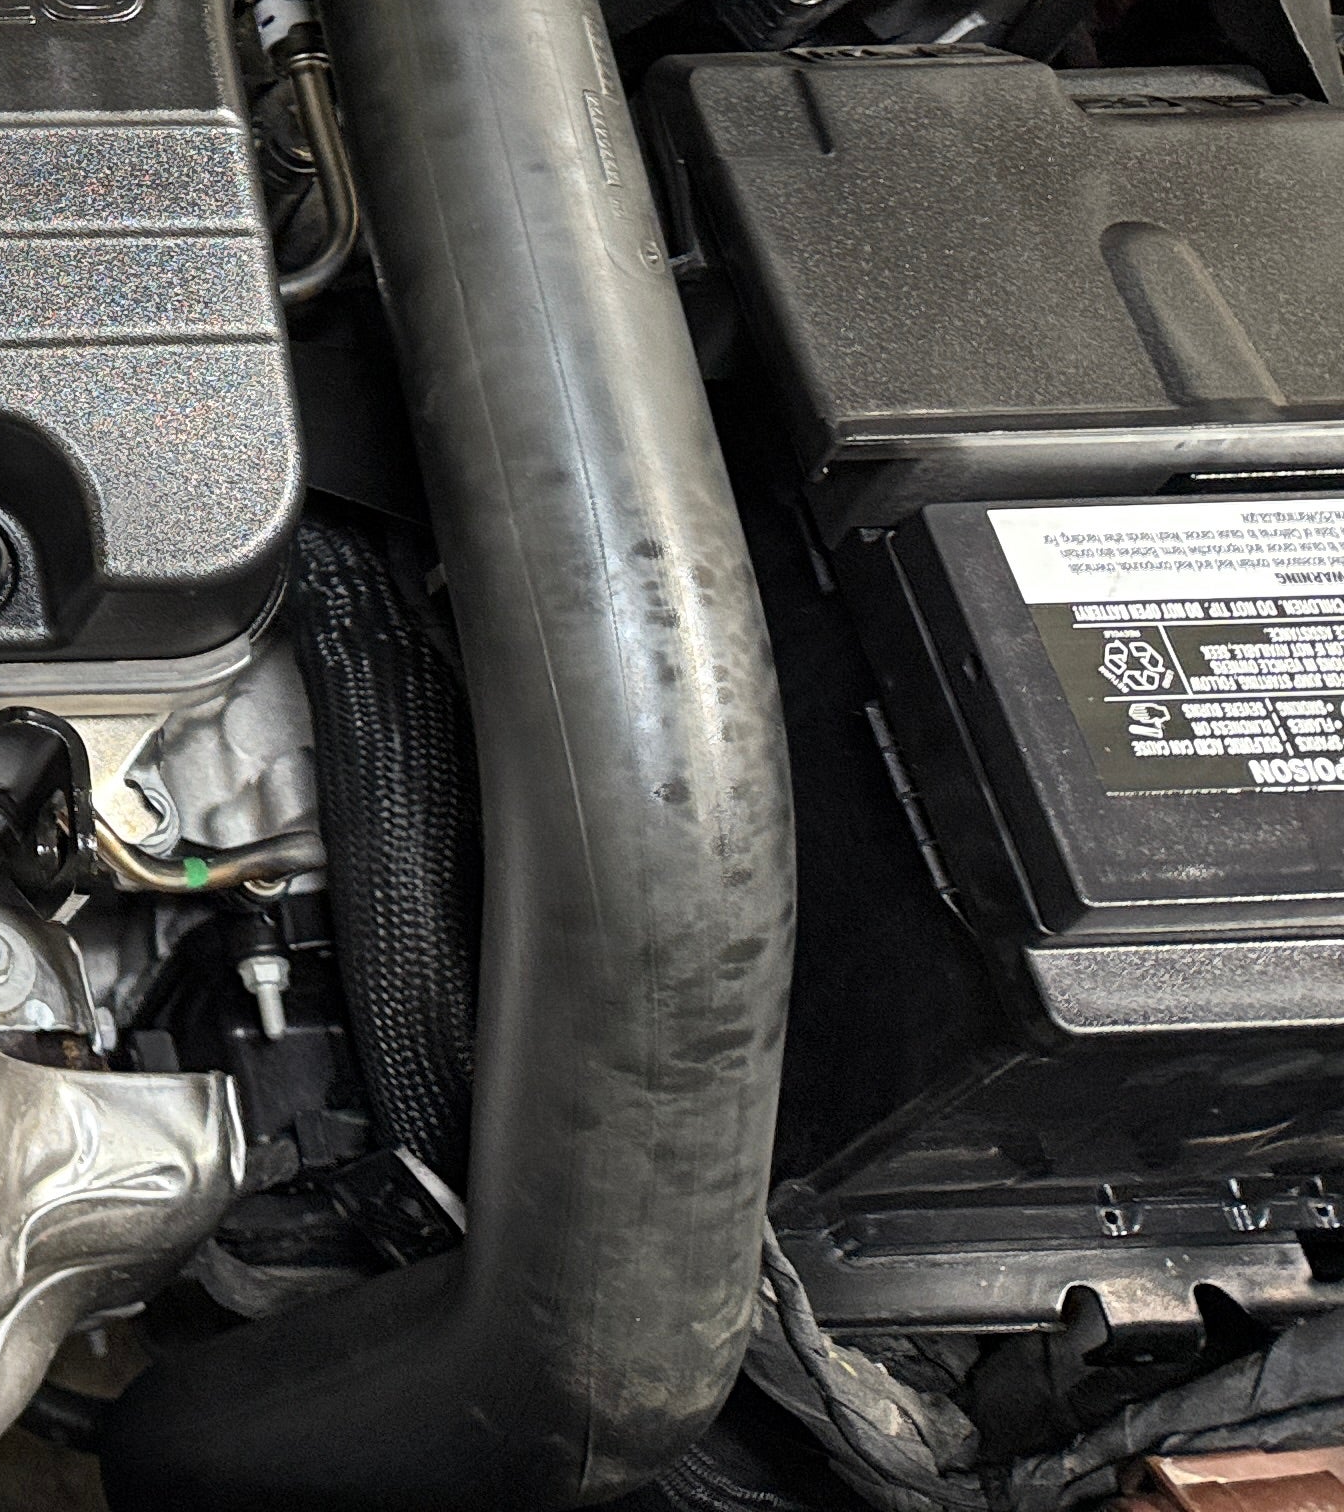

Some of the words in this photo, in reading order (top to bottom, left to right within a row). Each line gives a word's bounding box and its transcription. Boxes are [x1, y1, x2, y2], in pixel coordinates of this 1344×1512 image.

[1128, 603, 1162, 620] OPEN
[1161, 602, 1187, 619] NOT
[1229, 601, 1257, 617] NOT
[1255, 600, 1279, 616] DO
[1289, 642, 1315, 657] NOT
[1190, 675, 1238, 692] FOLLOW
[1220, 702, 1267, 718] SEVERE
[1191, 721, 1212, 736] OR
[1131, 740, 1171, 757] CAUSE
[1169, 739, 1194, 756] CAN
[1193, 738, 1225, 756] ACID
[1248, 757, 1344, 784] POISON
